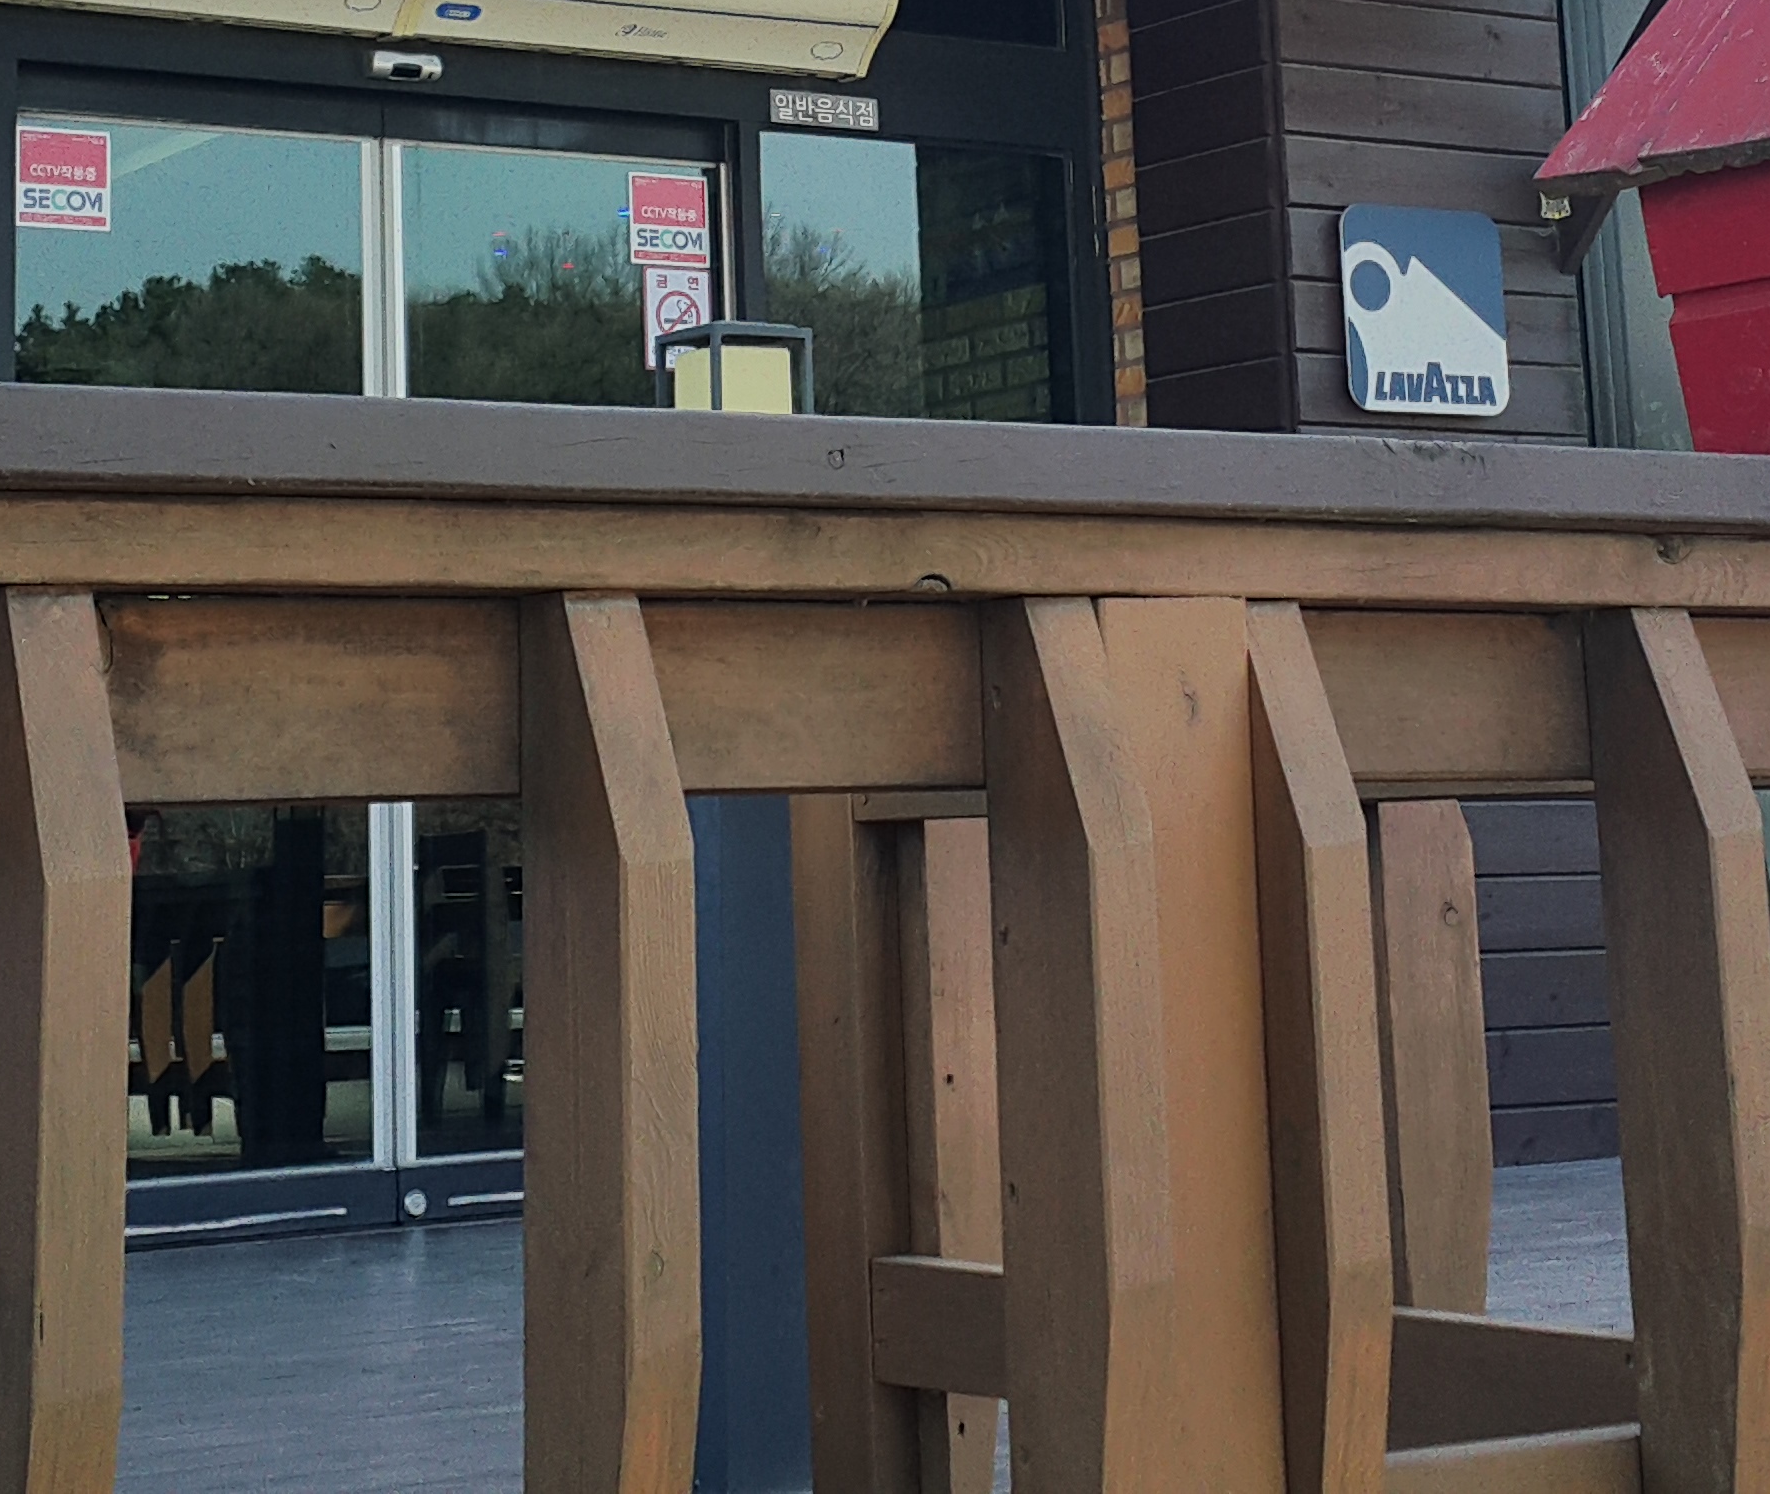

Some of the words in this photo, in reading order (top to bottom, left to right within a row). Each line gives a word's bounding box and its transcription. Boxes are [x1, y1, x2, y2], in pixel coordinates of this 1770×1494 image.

[774, 94, 874, 127] 일반음식점
[23, 188, 103, 213] SECOM
[636, 227, 703, 252] SECOM
[1374, 361, 1497, 406] LAVAZZA
